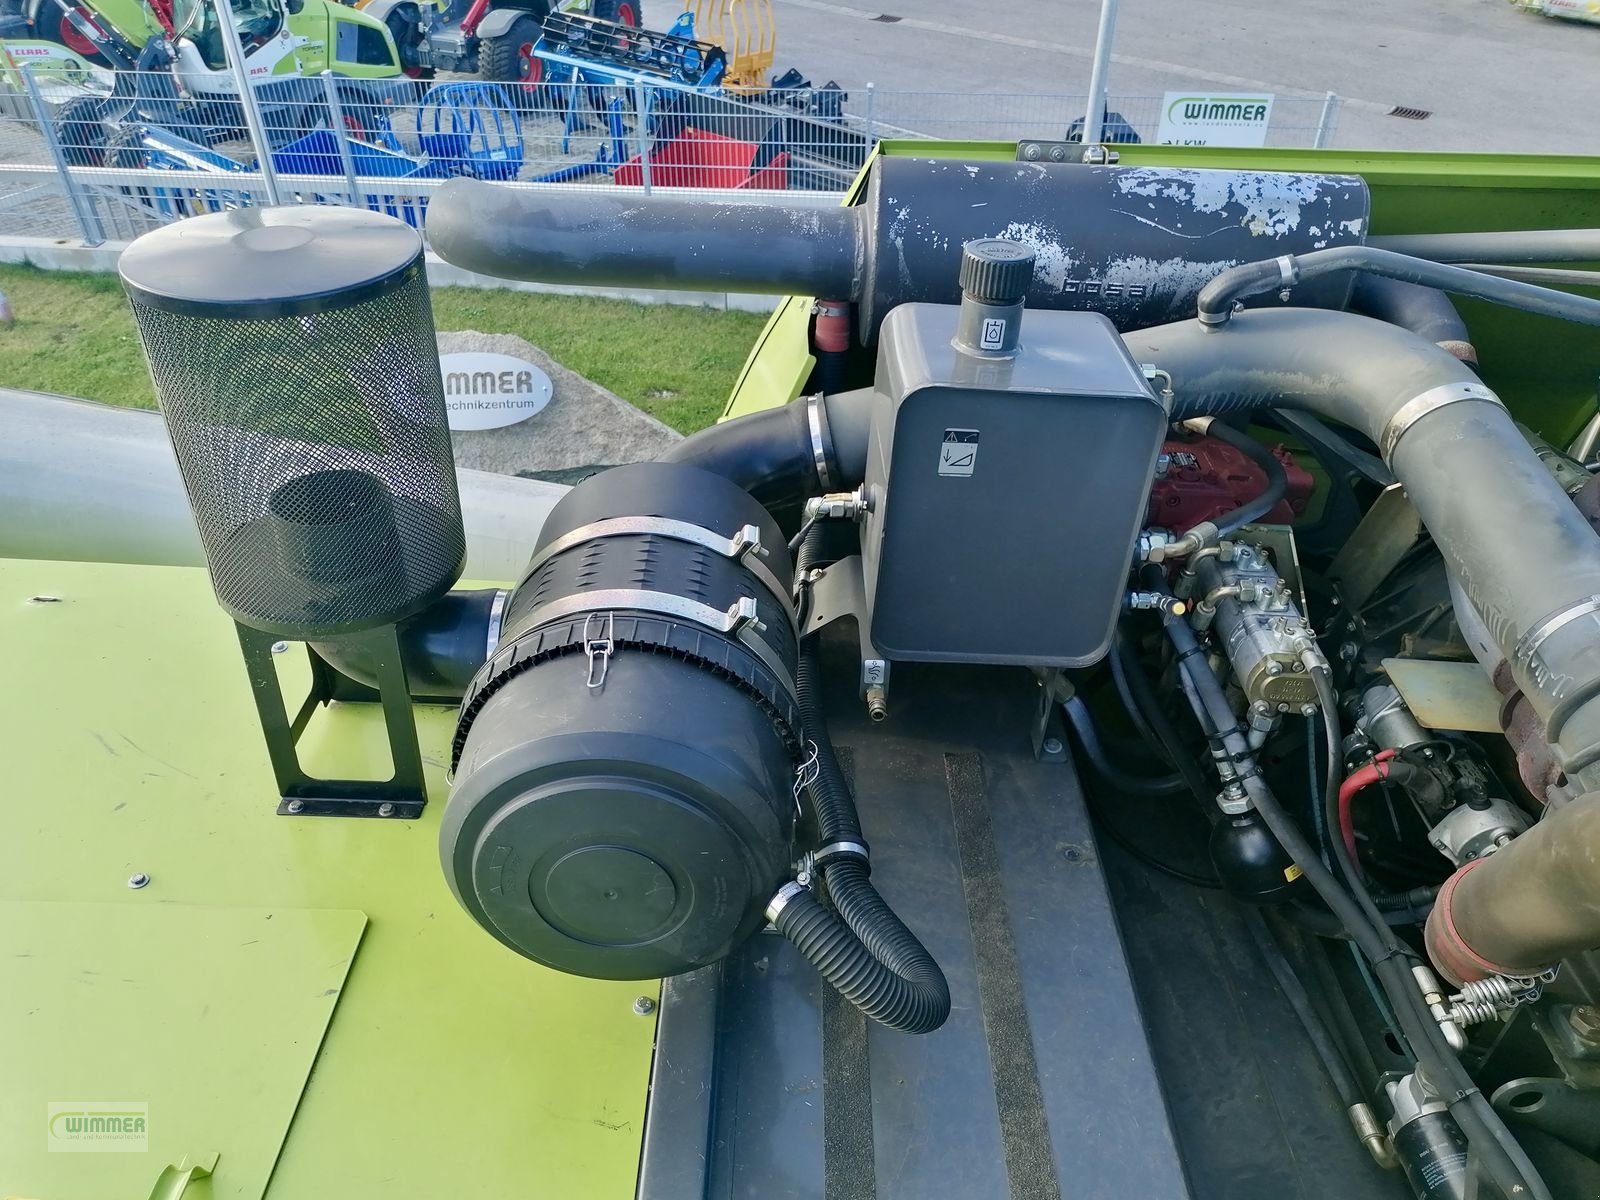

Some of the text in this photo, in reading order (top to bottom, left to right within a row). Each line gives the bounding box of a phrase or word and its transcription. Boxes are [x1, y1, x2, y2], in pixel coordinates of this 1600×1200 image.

[250, 66, 269, 75] AAS
[1184, 103, 1267, 121] WIMMER
[446, 370, 533, 396] MMER
[446, 399, 535, 411] echnikzentrum
